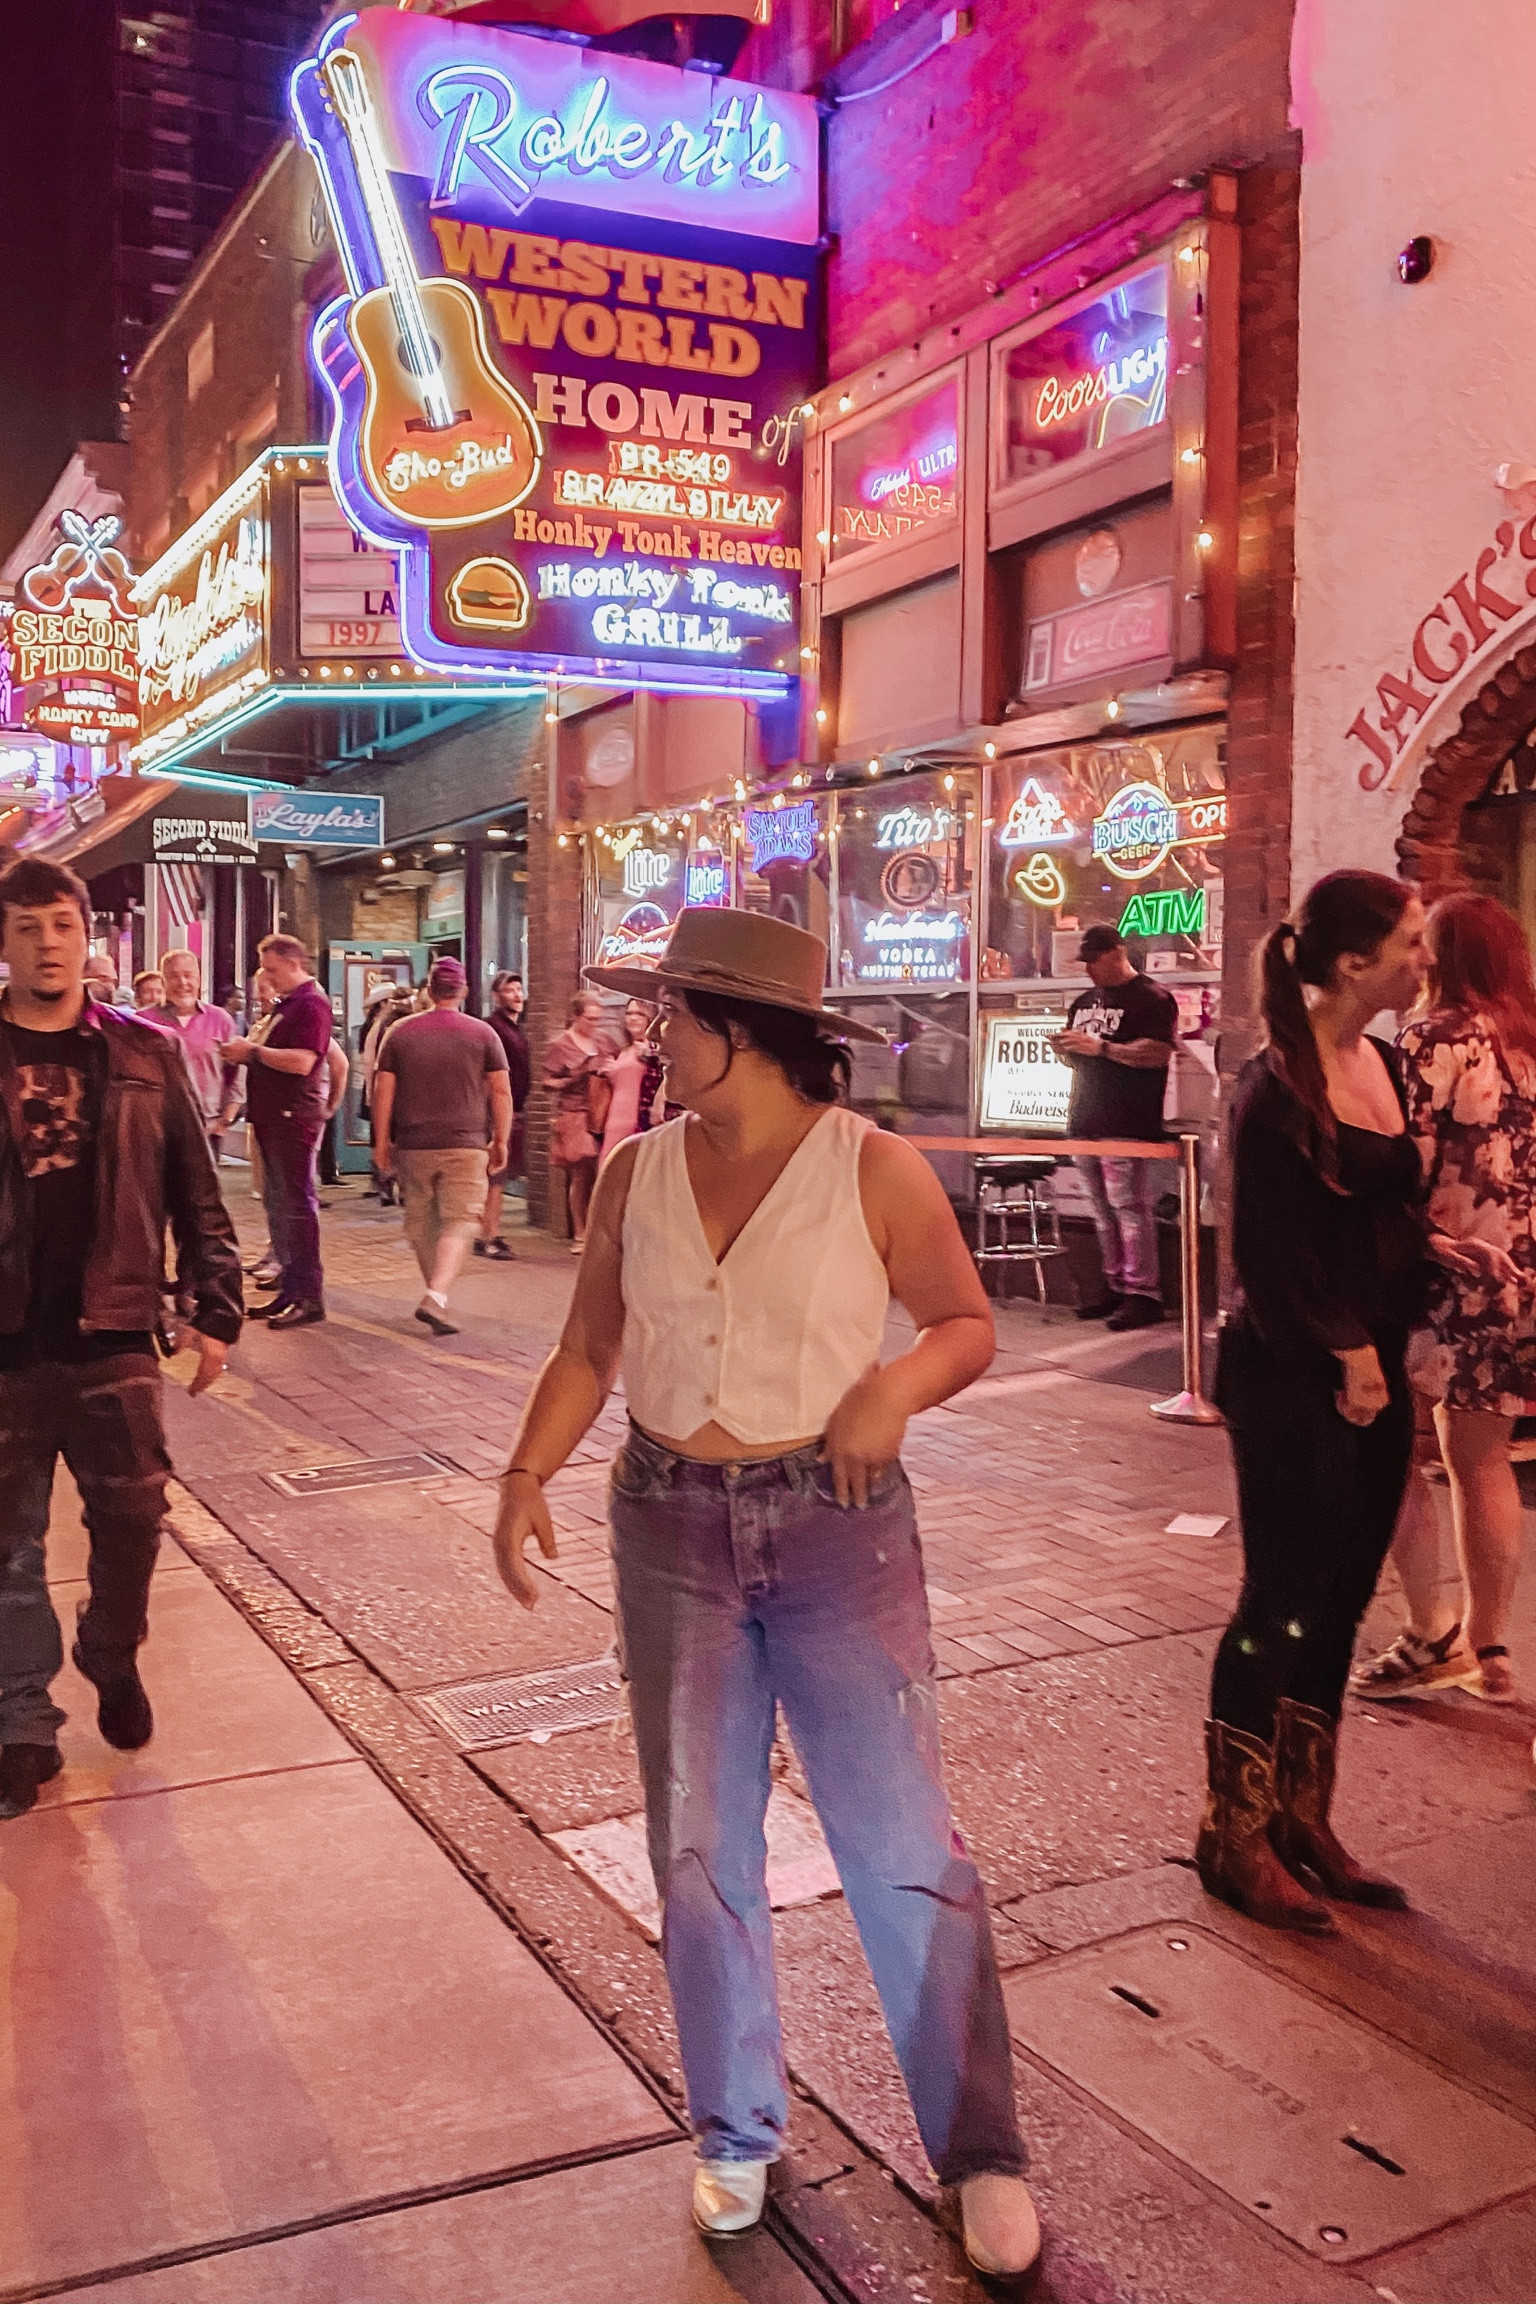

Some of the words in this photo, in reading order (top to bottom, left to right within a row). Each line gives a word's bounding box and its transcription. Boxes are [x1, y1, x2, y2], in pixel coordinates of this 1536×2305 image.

[416, 64, 796, 214] Robert's
[430, 216, 808, 329] WESTERN
[485, 288, 762, 376] WORLD
[1036, 365, 1107, 428] Coors
[1108, 336, 1168, 395] LIGH
[532, 374, 753, 449] HOME
[762, 405, 801, 466] of
[513, 508, 612, 558] Honky
[617, 520, 692, 558] Tonk
[698, 529, 803, 570] Heaven
[537, 560, 678, 608] Honky
[687, 566, 793, 622] Tonk
[328, 621, 383, 646] 1997
[591, 602, 742, 653] GRILL
[20, 644, 139, 682] FIDDL
[153, 818, 207, 849] SECOND
[208, 820, 259, 853] FIDDL
[255, 803, 376, 836] Layla's
[748, 800, 819, 842] SAMUEL
[874, 806, 950, 848] Tito's
[1093, 810, 1178, 853] BUSCH
[752, 831, 814, 872] ADAMS
[1118, 888, 1206, 938] ATM
[879, 947, 936, 963] VODKA
[998, 1039, 1061, 1064] ROBE
